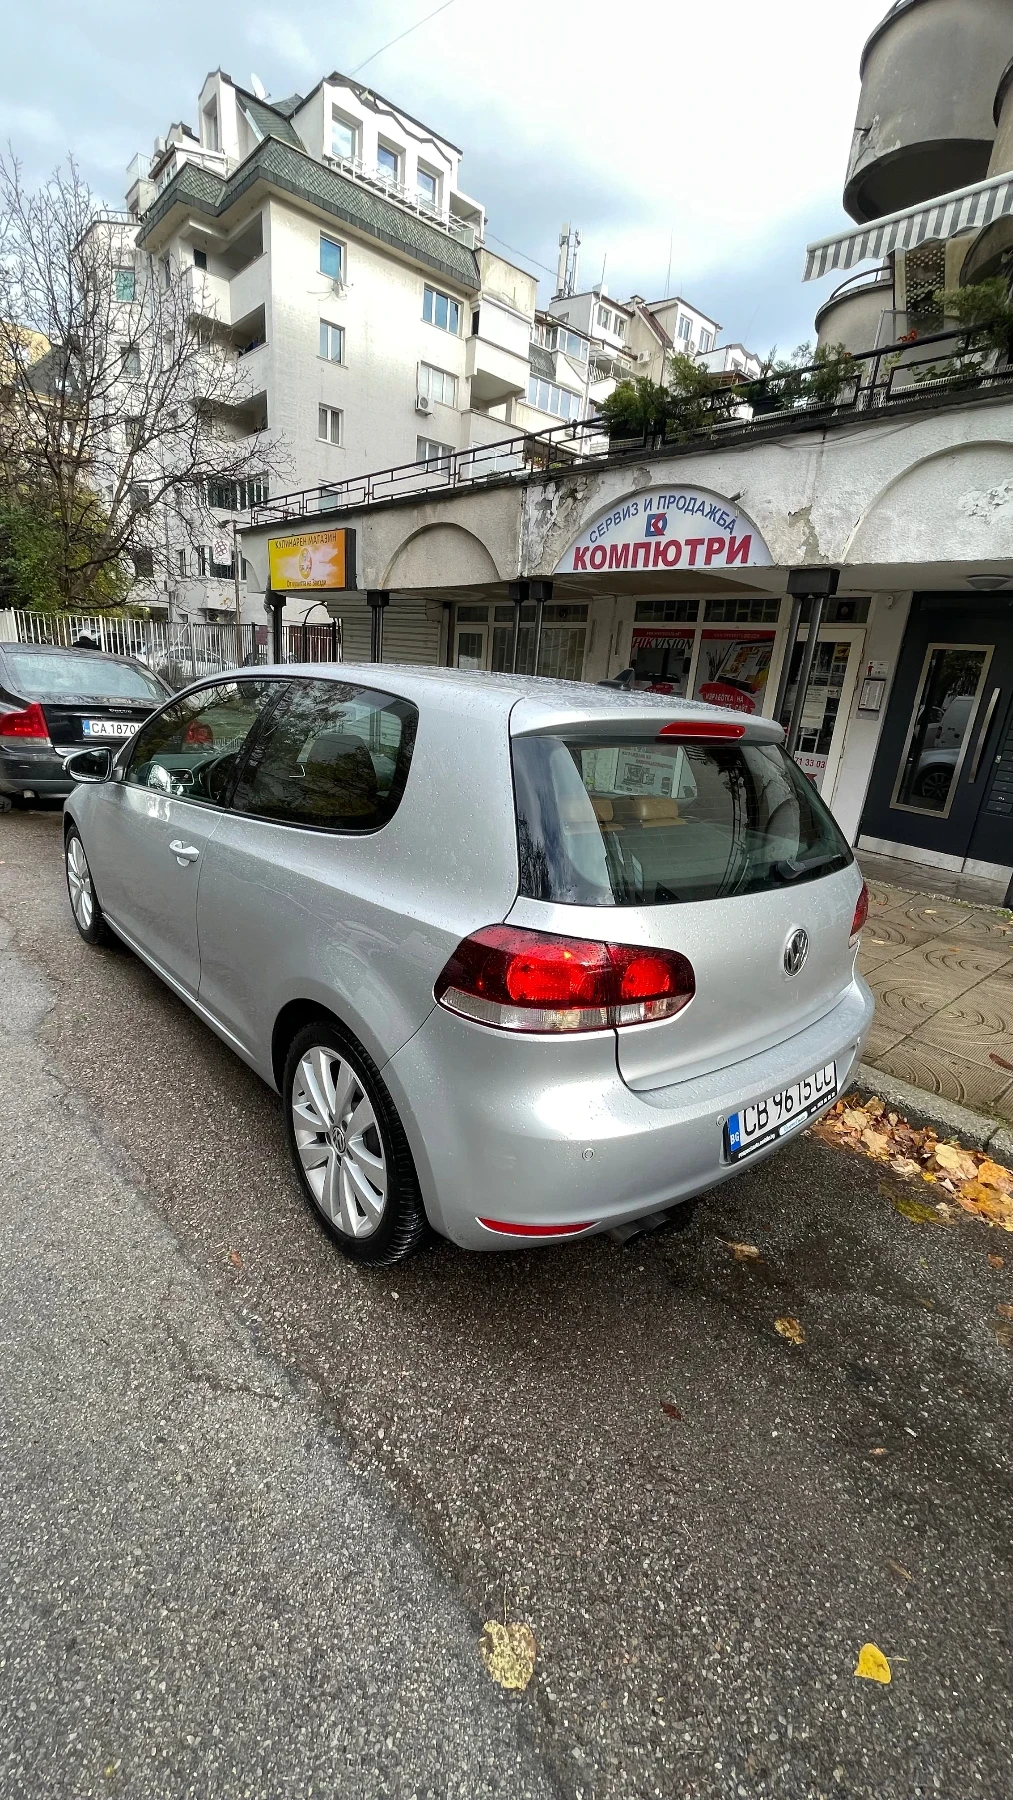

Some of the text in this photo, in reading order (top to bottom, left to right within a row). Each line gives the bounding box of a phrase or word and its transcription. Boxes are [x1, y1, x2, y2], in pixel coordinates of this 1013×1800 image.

[589, 494, 737, 544] СЕРВИЗ И ПРОДАЖБА
[275, 532, 337, 549] КУЛИНАРЕН МАГАЗИН
[572, 534, 752, 571] КОМПЮТРИ
[632, 637, 695, 650] HIKVISION
[705, 692, 744, 703] ИЗРАБОТКА НА
[743, 1100, 769, 1136] CB
[772, 1080, 812, 1121] 9615
[730, 1131, 740, 1146] BG
